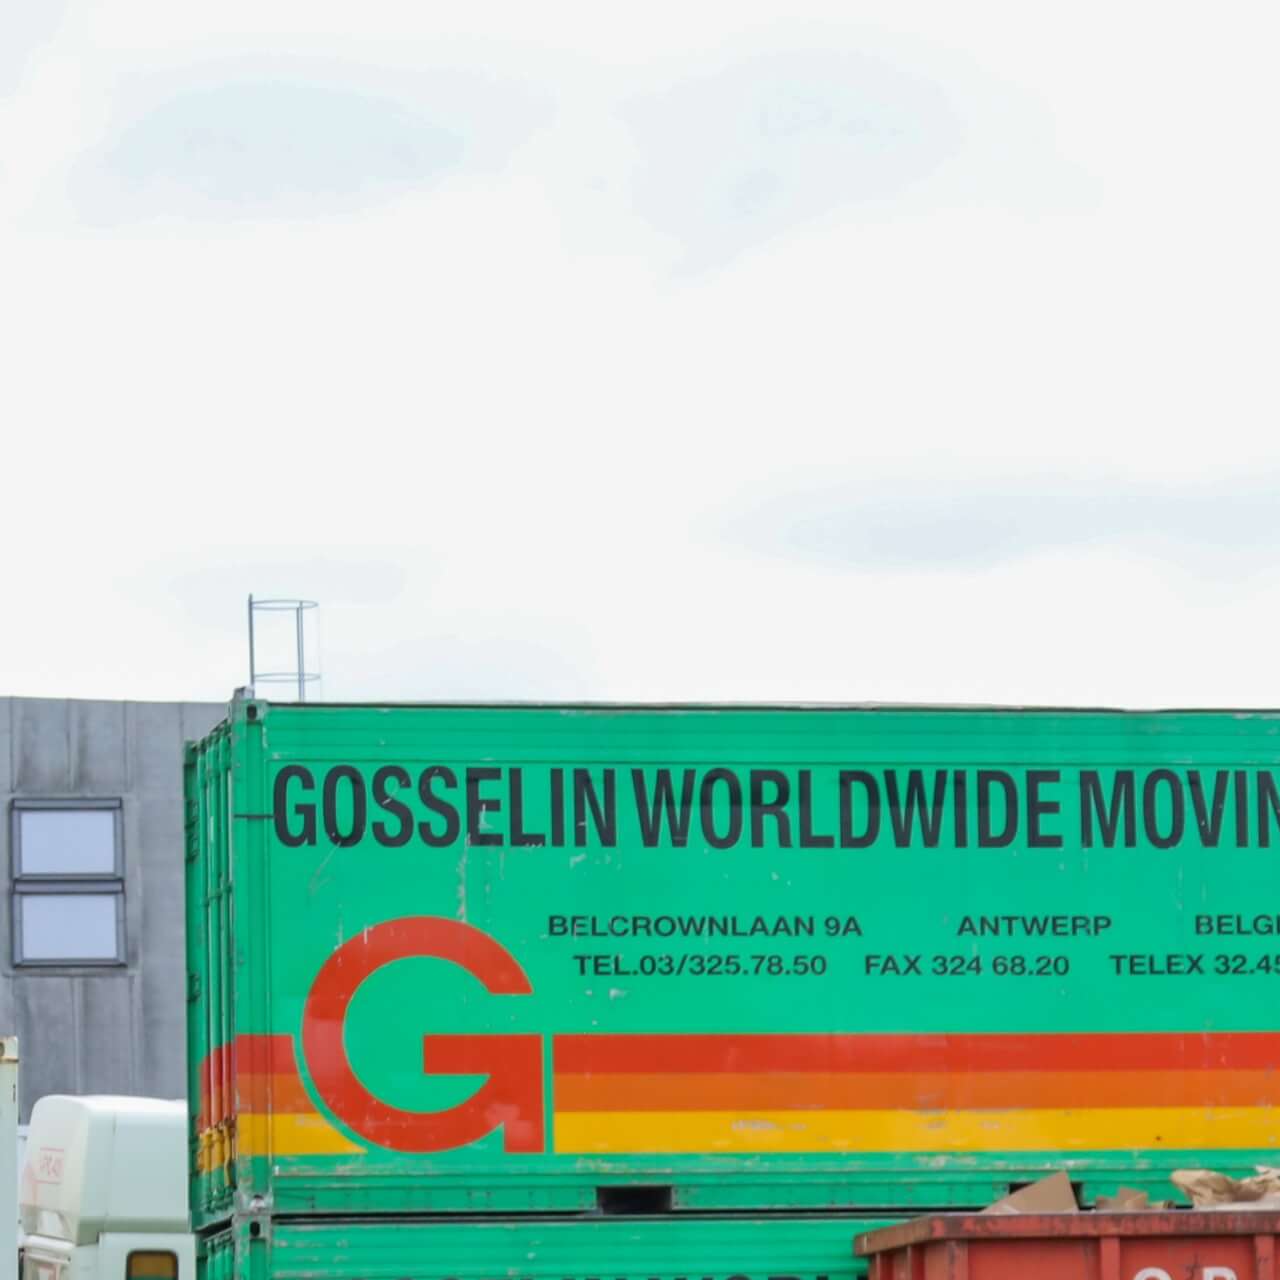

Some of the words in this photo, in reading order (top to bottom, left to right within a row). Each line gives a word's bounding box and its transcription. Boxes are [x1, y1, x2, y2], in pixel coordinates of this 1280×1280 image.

[272, 766, 616, 848] GOSSELIN
[632, 768, 1062, 848] WORLDWIDE
[548, 915, 815, 936] BELCROWNLAAN
[825, 916, 862, 936] 9A
[957, 915, 1112, 936] ANTWERP
[865, 955, 921, 975] FAX
[932, 955, 982, 976] 324
[992, 955, 1070, 976] 68.20
[1110, 954, 1204, 975] TELEX
